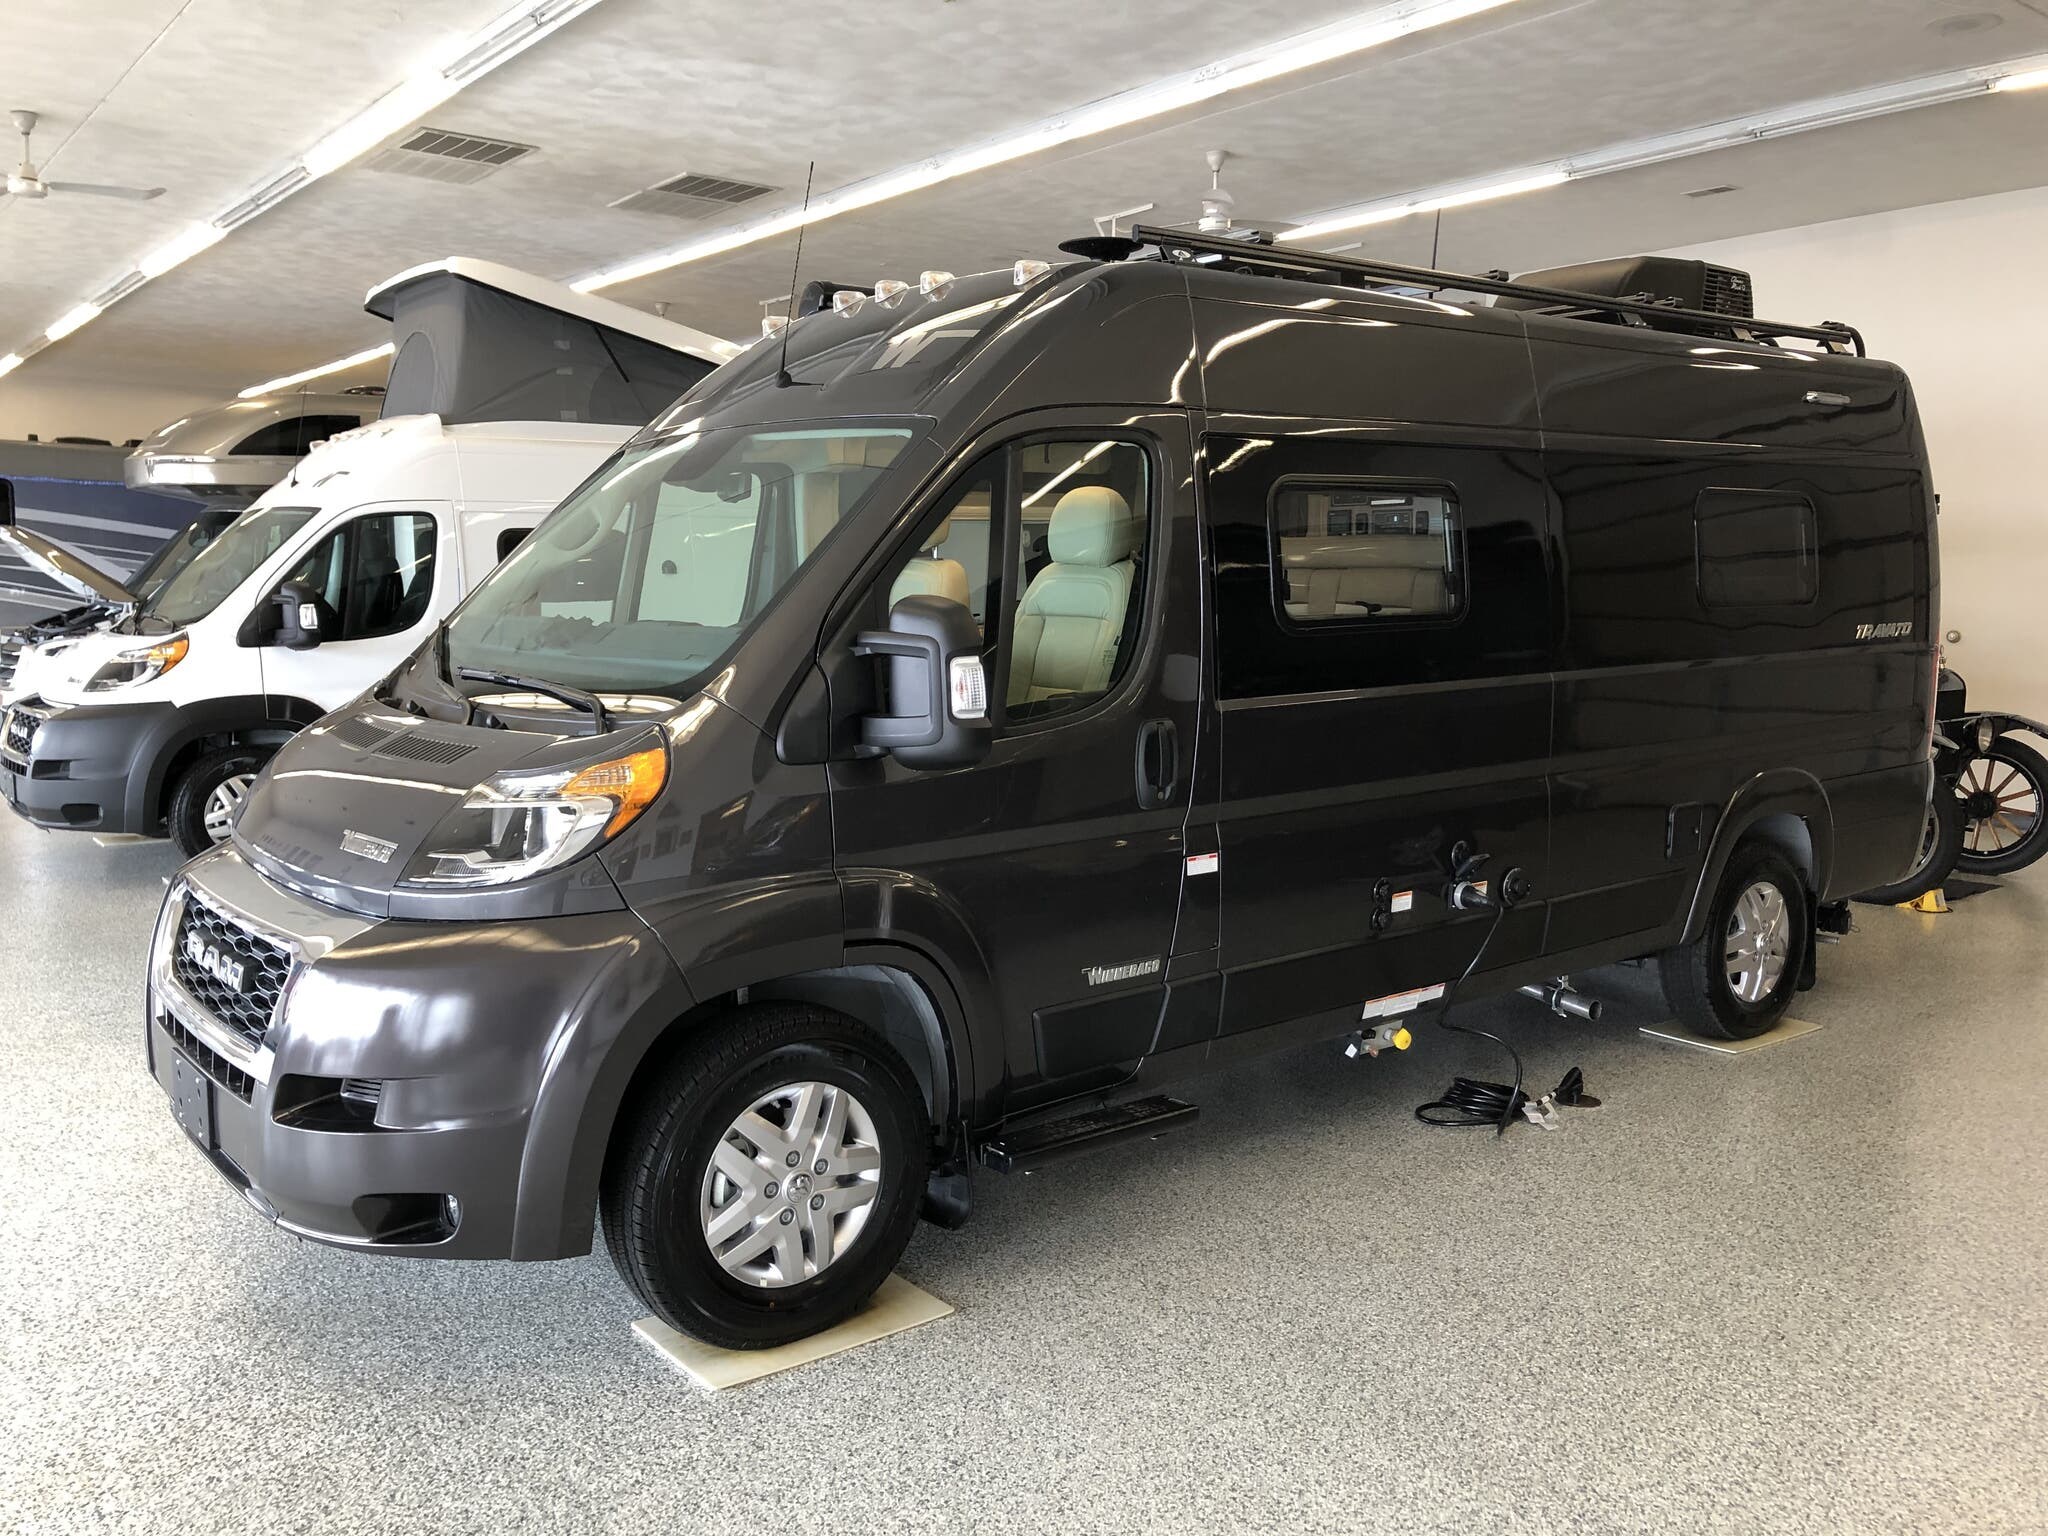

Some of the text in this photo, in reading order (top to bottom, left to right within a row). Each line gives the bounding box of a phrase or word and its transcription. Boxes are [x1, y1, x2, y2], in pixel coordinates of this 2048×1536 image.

[1856, 622, 1912, 640] TRAVATO
[187, 929, 244, 993] RAM
[1081, 959, 1160, 986] WINNEBAGO
